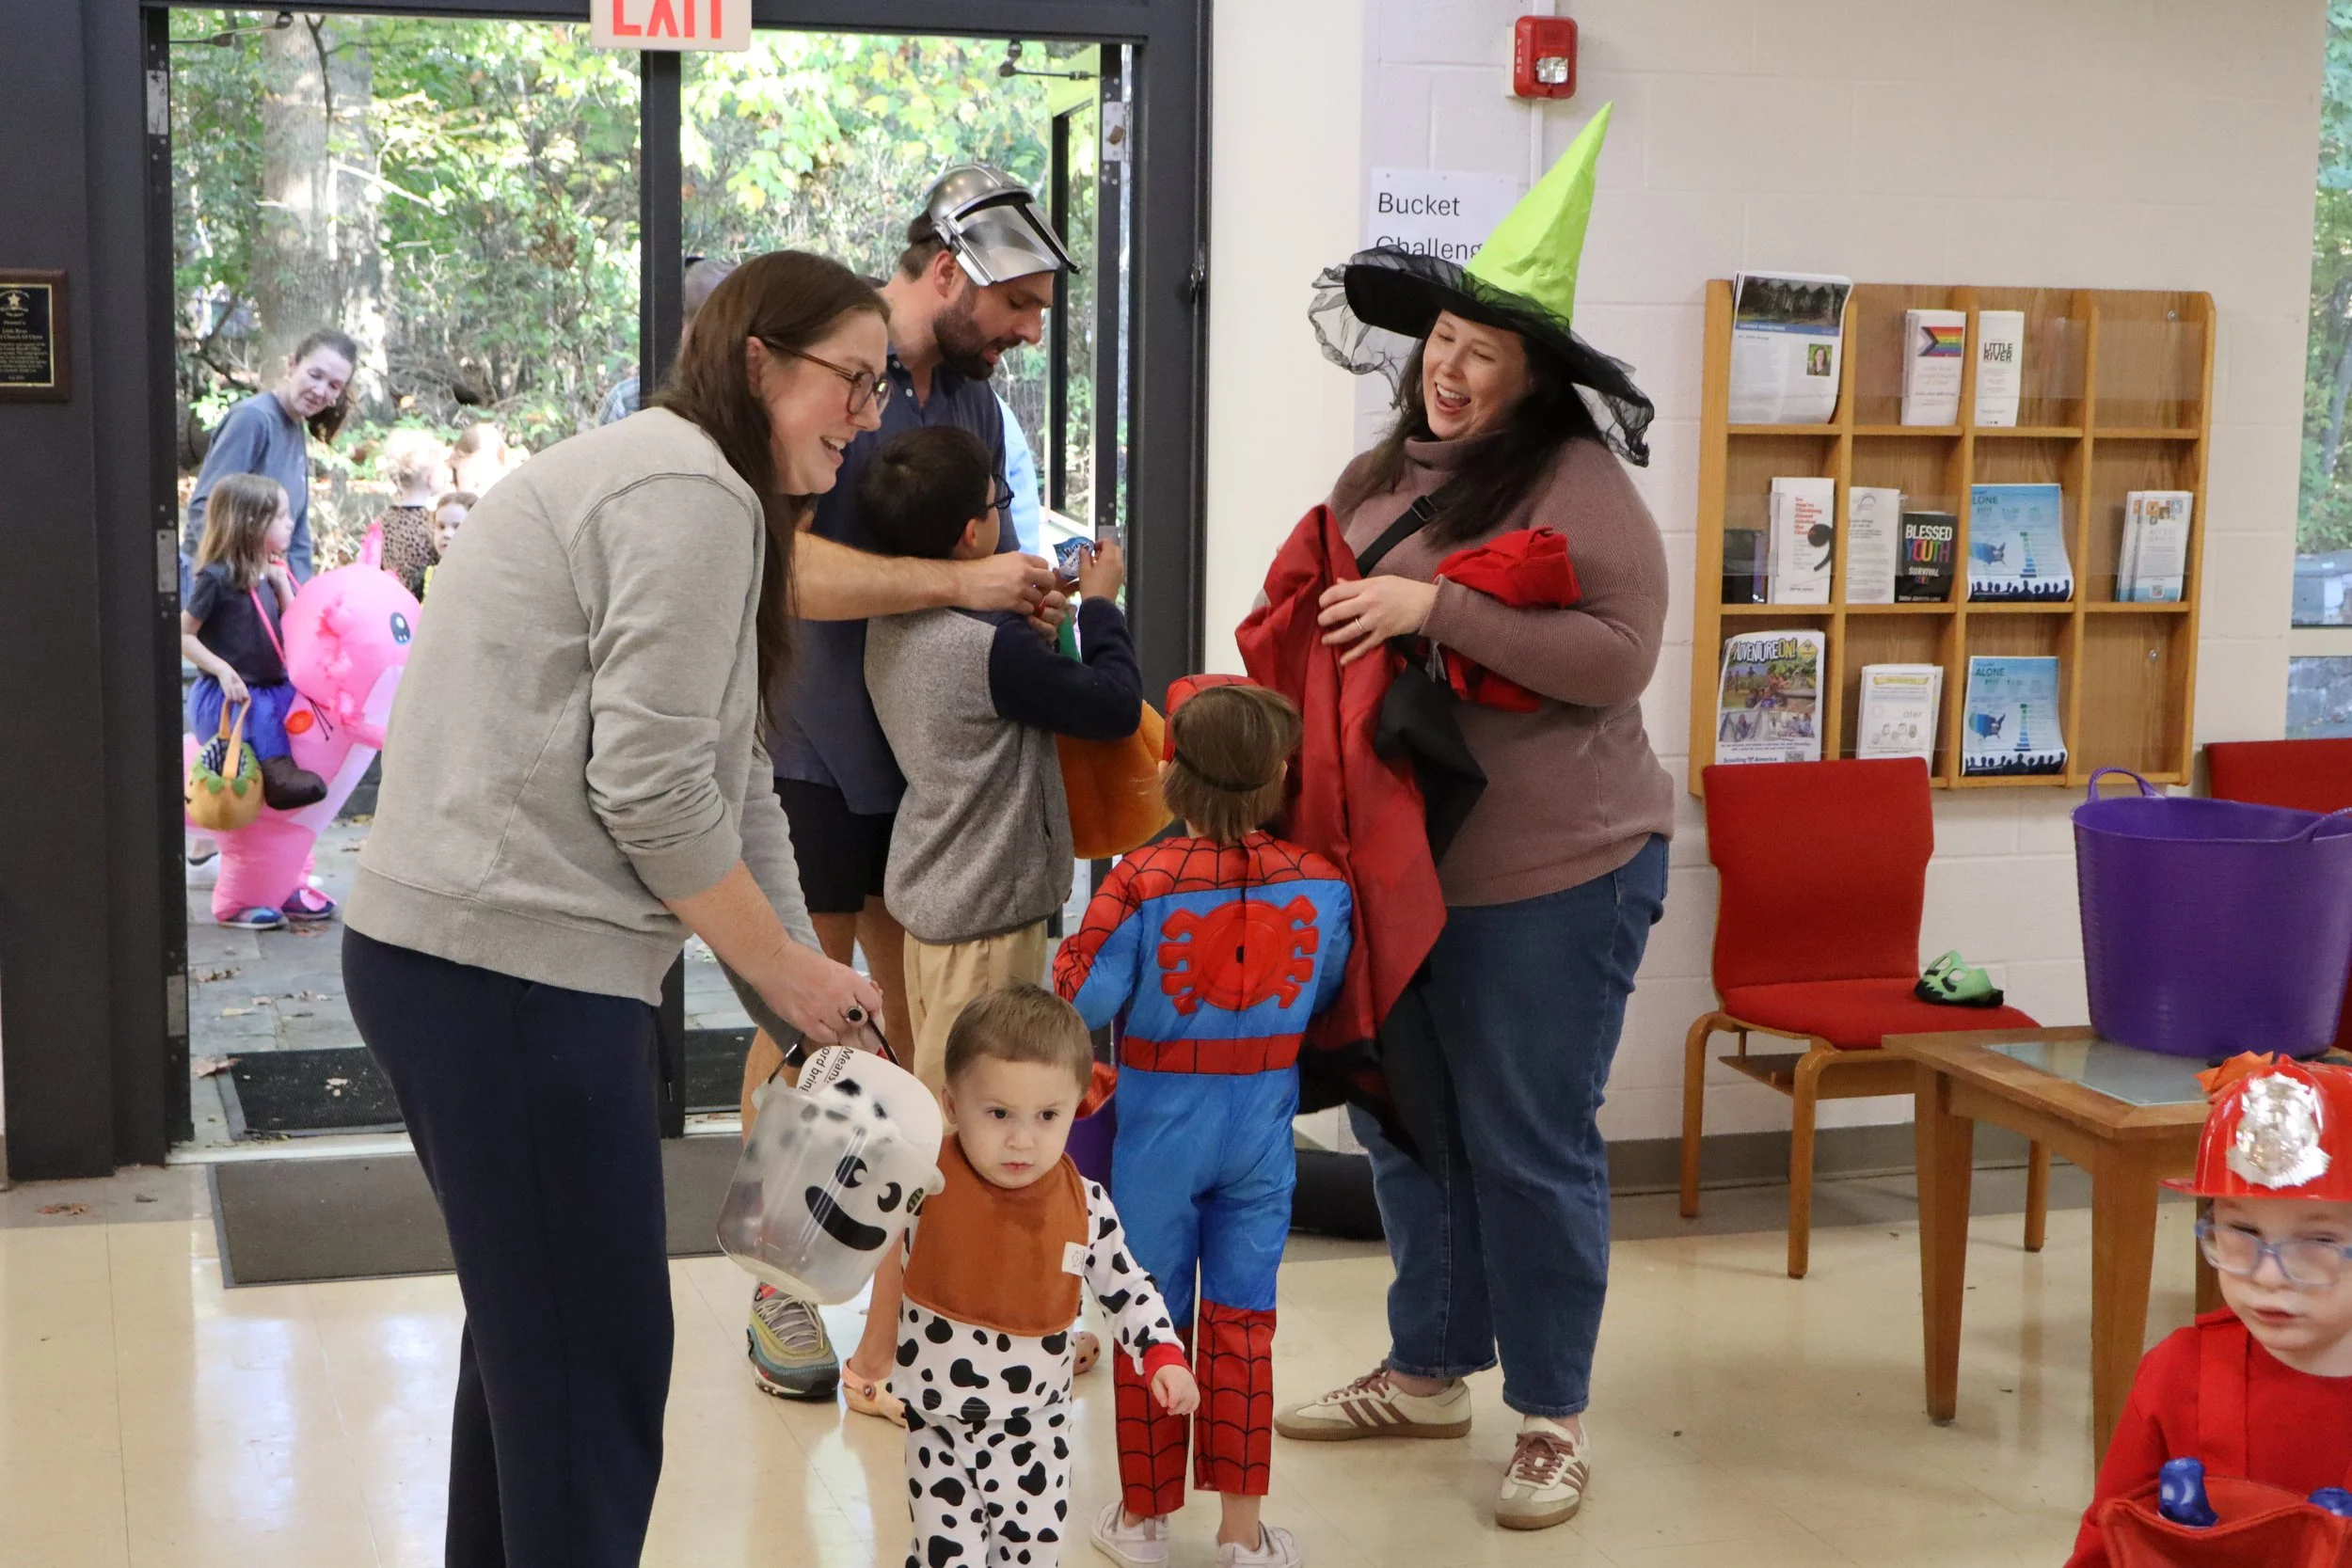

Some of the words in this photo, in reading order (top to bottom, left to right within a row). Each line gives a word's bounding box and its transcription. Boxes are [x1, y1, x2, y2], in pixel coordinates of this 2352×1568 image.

[1378, 192, 1460, 216] Bucket
[1376, 236, 1484, 260] Challen
[1983, 342, 2013, 353] LITTLE
[1983, 351, 2012, 362] RIVER
[1972, 496, 1999, 505] LONE
[1905, 524, 1953, 542] BLESSED
[1905, 538, 1952, 563] YOUTH
[1975, 667, 2005, 677] ALONE
[816, 1046, 832, 1069] ord
